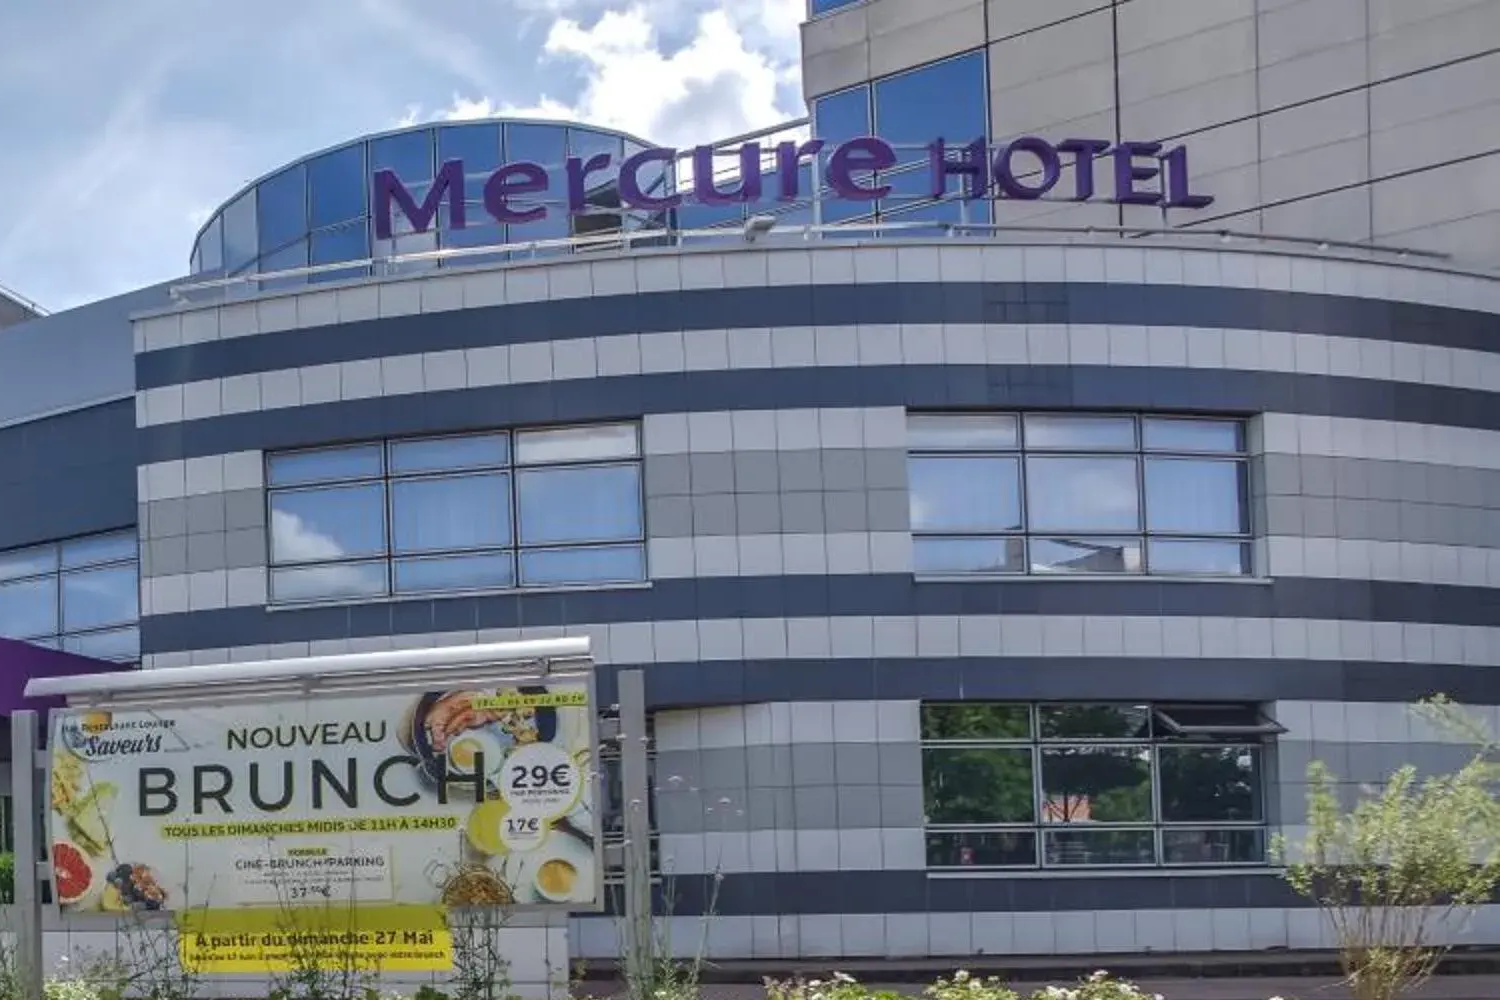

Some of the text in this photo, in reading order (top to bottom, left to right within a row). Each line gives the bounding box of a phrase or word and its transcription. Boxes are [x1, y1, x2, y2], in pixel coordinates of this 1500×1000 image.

[373, 136, 1215, 240] Mercure HOTEL
[227, 720, 386, 750] NOUVEAU
[138, 751, 485, 817] BRUNCH
[511, 764, 570, 788] 29€
[165, 825, 199, 837] TOUS
[202, 824, 226, 836] LES
[228, 822, 303, 836] DIMANCHES
[307, 819, 345, 833] MIDIS
[350, 819, 370, 831] DE
[372, 818, 397, 832] 11H
[414, 816, 457, 829] 14H30
[507, 817, 540, 833] 17€
[211, 933, 257, 950] partir
[262, 932, 284, 946] du
[288, 930, 369, 946] dimanche
[375, 930, 397, 945] 27
[404, 929, 433, 945] Mai
